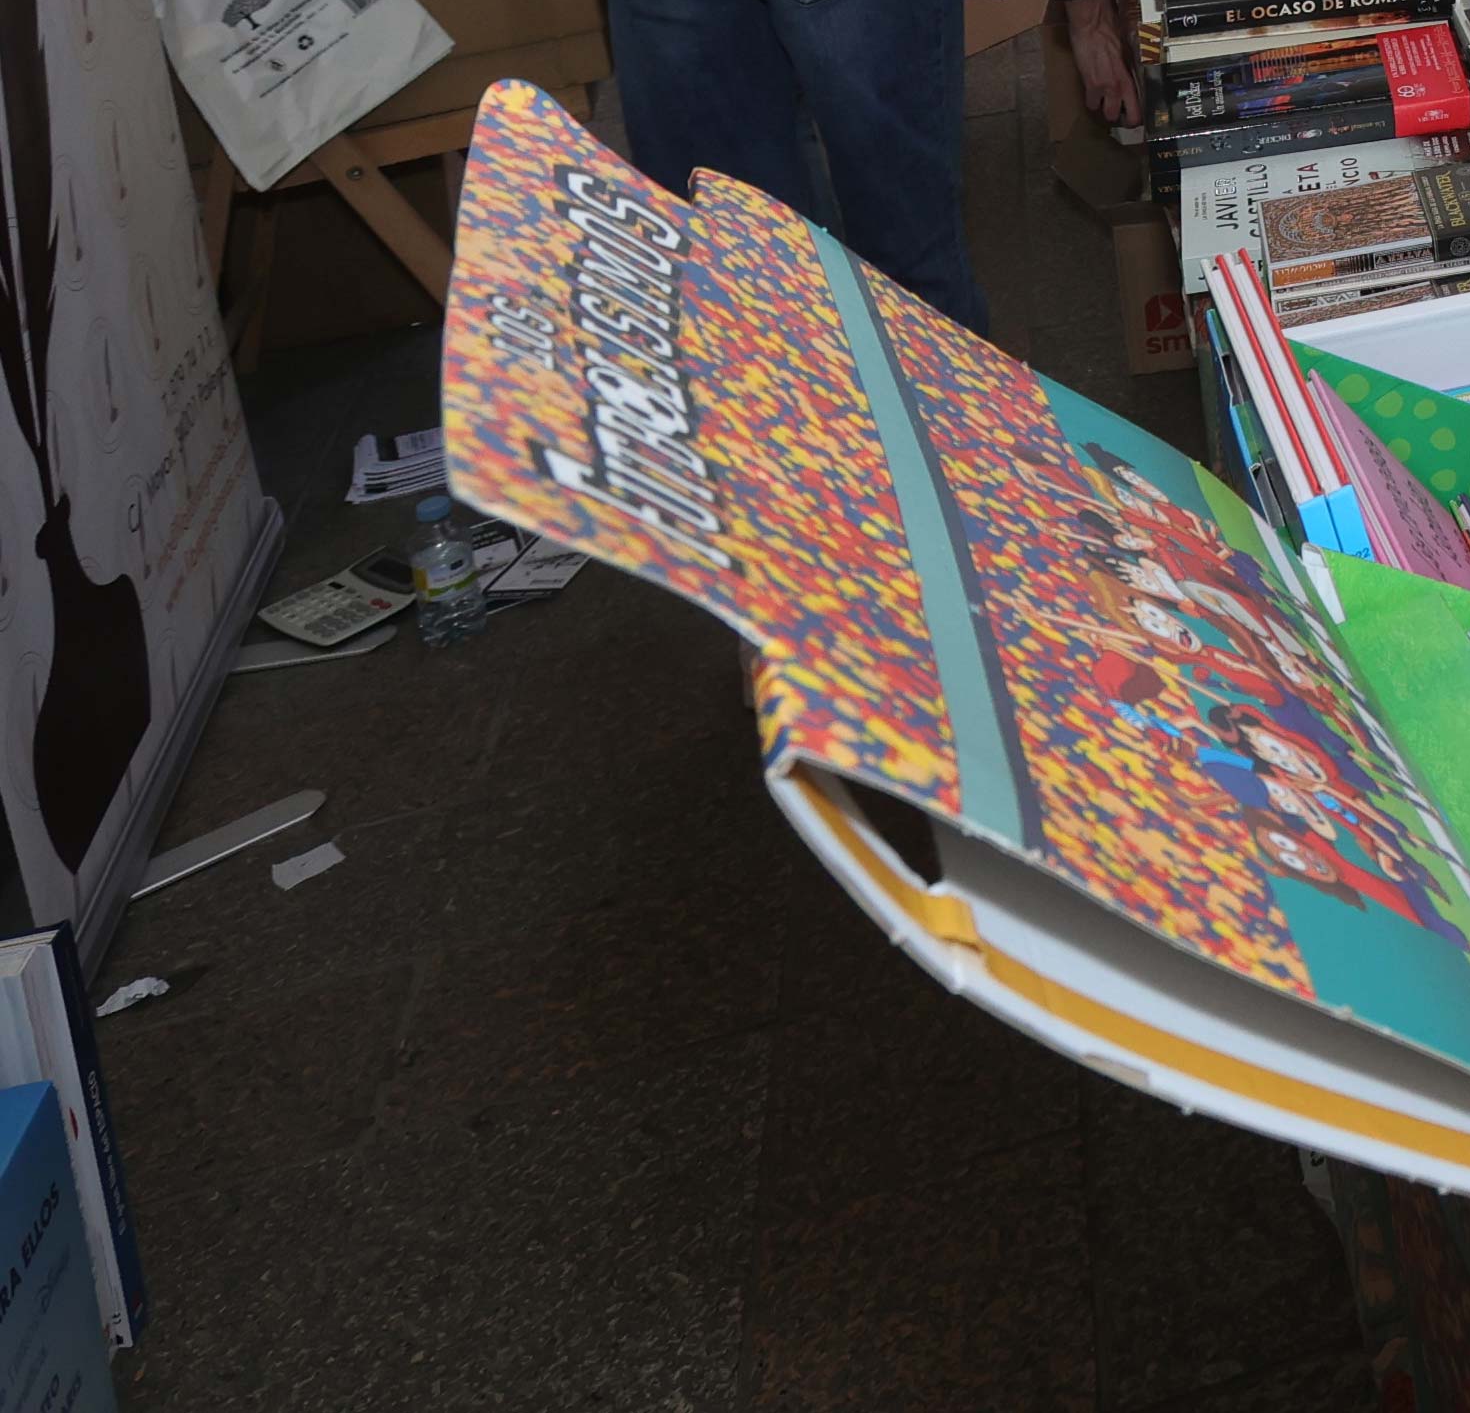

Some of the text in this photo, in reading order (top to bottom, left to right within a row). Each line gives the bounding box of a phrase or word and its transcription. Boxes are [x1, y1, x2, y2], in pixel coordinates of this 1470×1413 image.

[1226, 8, 1246, 23] EL
[1252, 0, 1315, 19] OCASO
[1215, 177, 1240, 231] JAVIER
[1440, 168, 1467, 230] BLACKWATER
[492, 294, 556, 371] LOS
[20, 1183, 60, 1270] ELLOS
